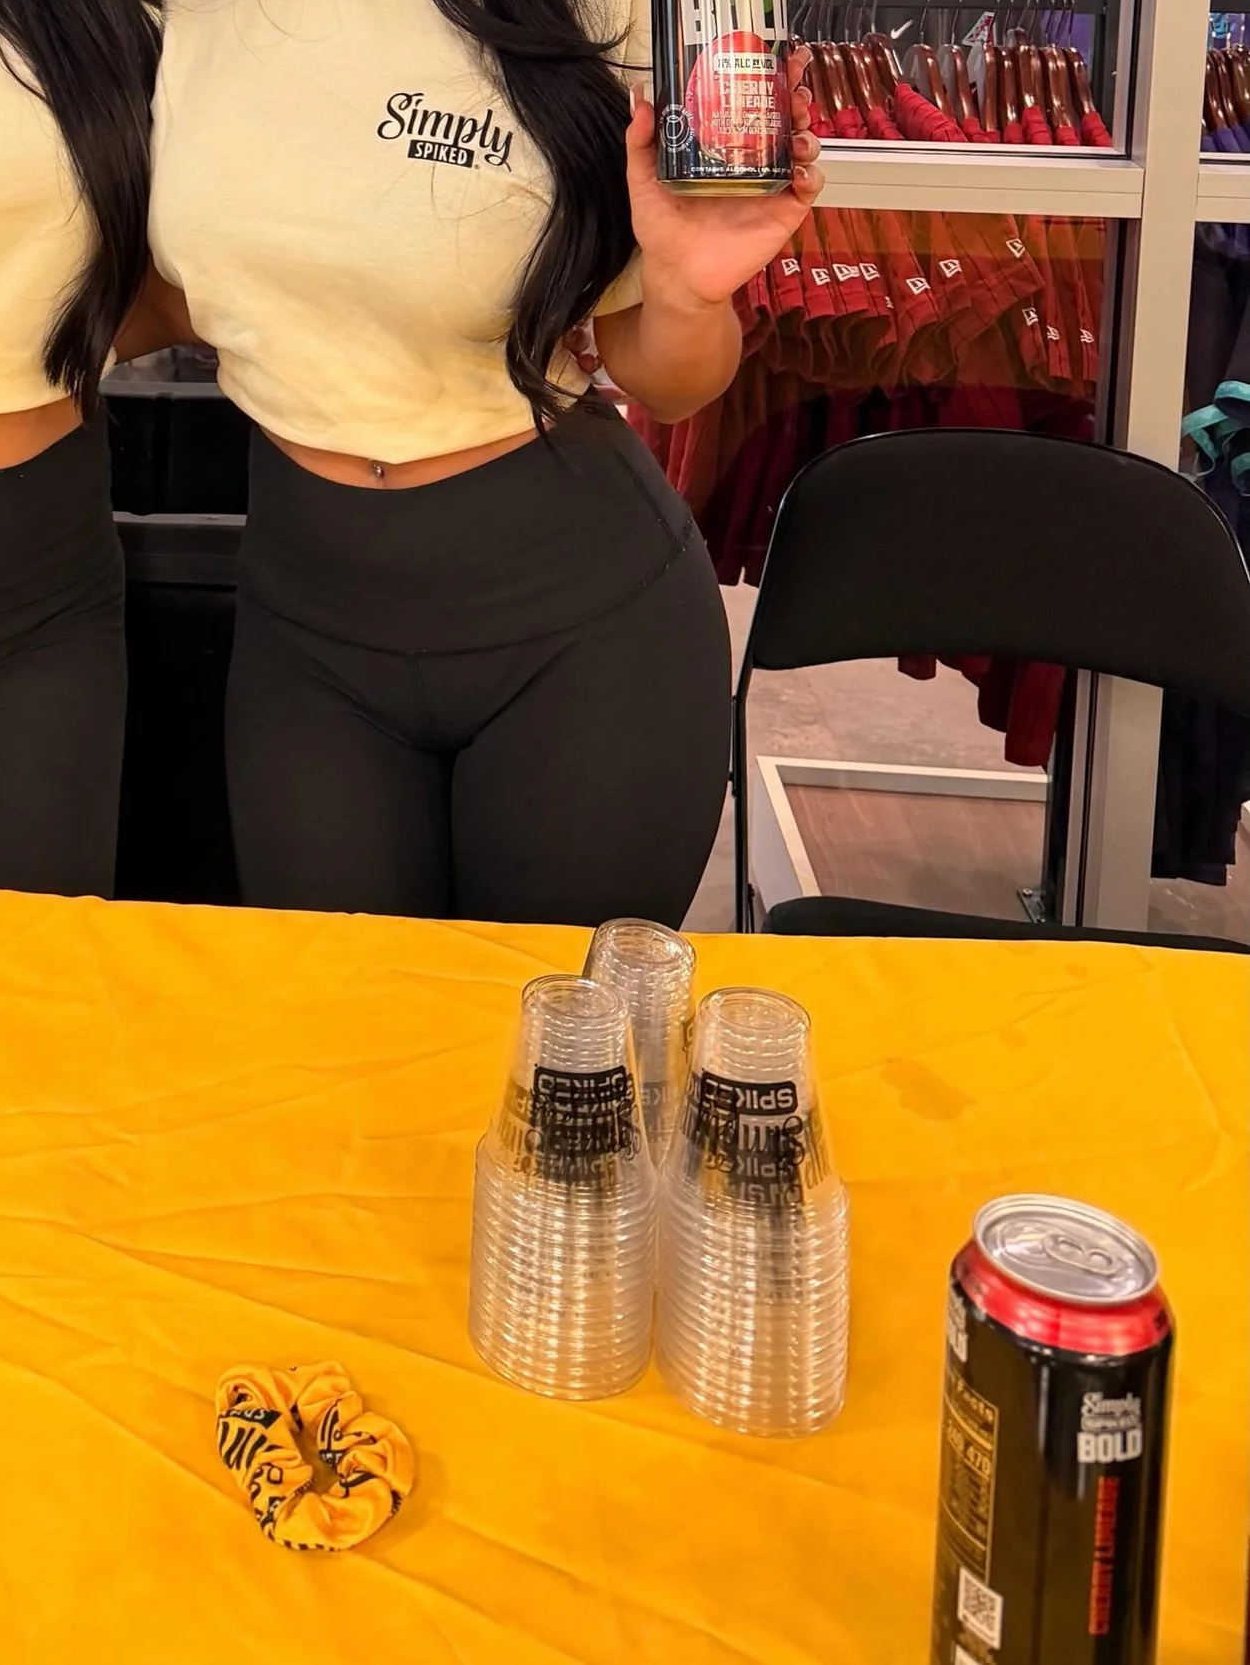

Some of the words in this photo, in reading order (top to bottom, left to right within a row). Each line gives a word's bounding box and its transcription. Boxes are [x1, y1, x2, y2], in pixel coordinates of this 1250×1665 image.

[734, 58, 751, 69] ALC
[721, 96, 776, 110] LMEADE
[377, 92, 513, 173] Simply
[414, 141, 468, 166] SPIKED
[1077, 1429, 1143, 1464] BOLD
